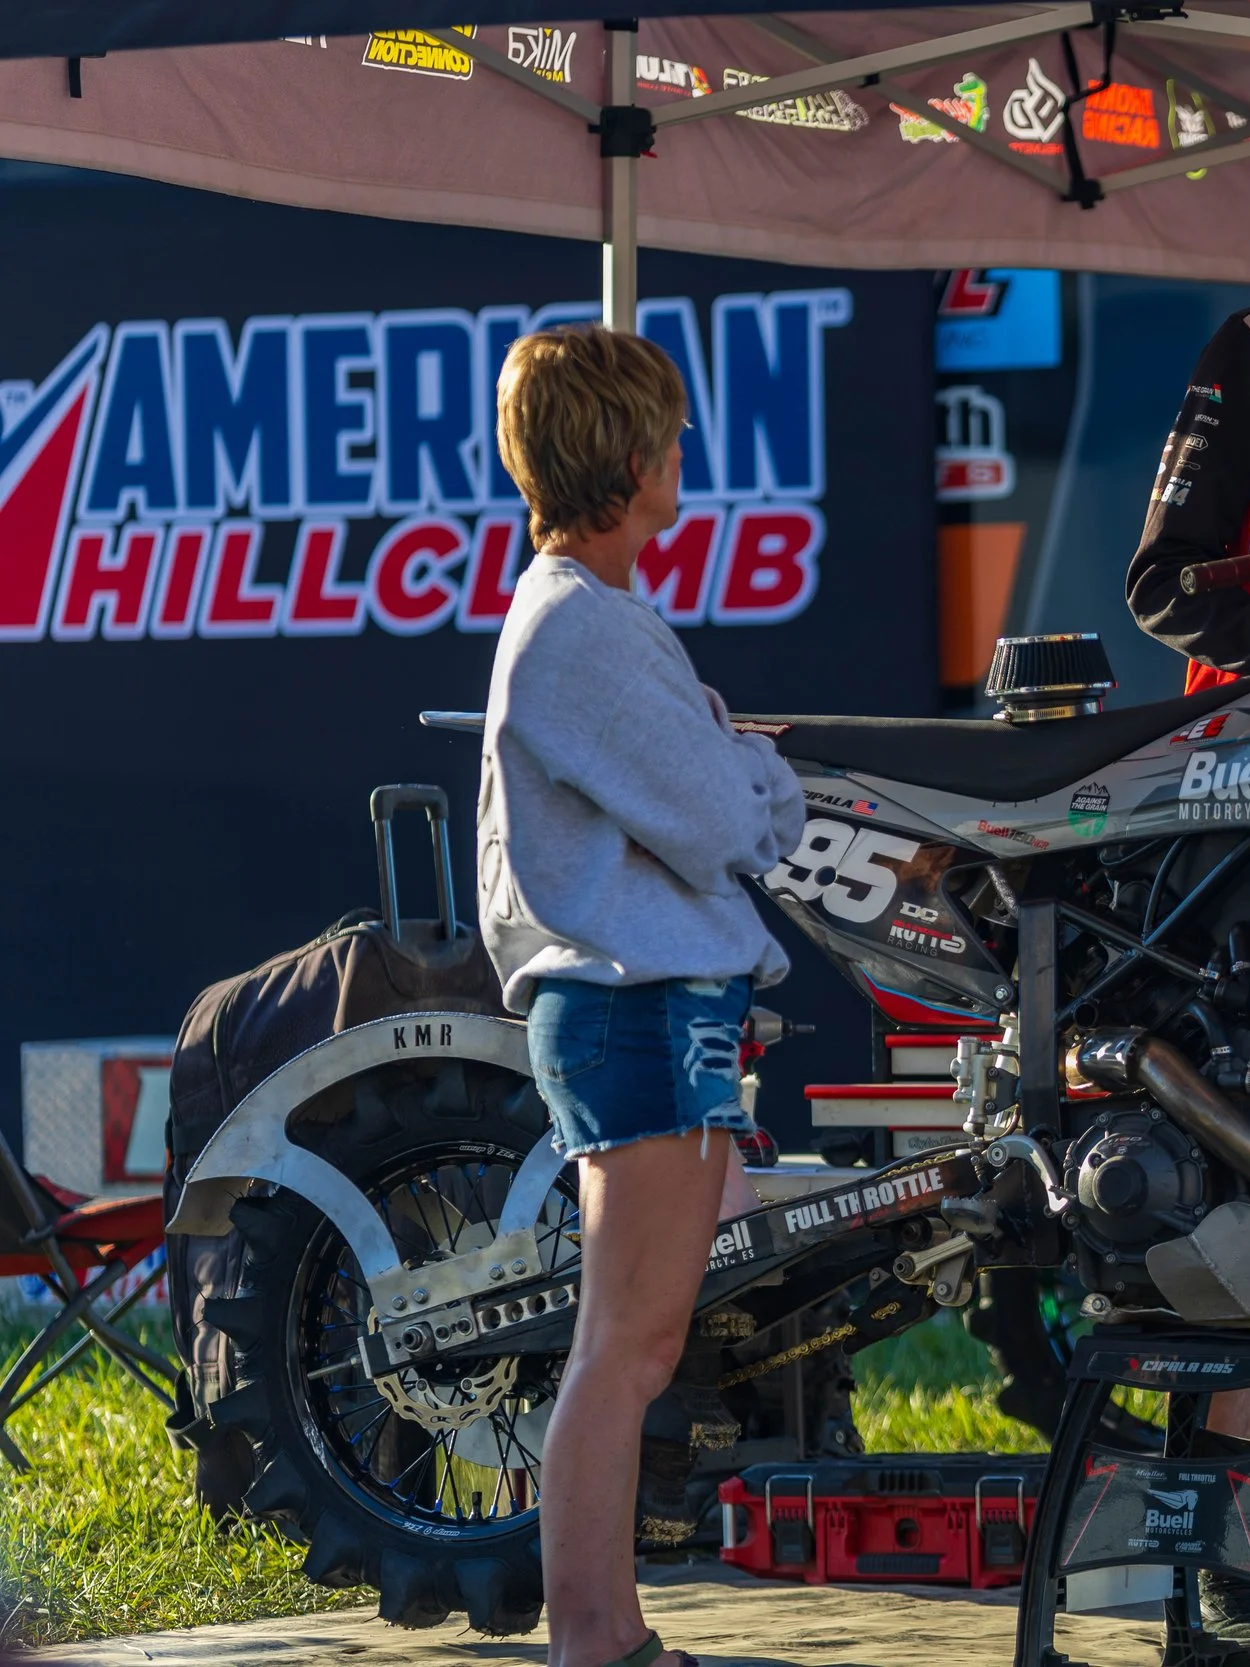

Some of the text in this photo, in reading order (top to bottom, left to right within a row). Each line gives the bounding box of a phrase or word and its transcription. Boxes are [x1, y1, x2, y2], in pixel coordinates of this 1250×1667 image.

[78, 294, 827, 521] AMERIAN
[52, 504, 827, 642] HILLCLMB
[1071, 802, 1086, 810] THE
[1075, 796, 1107, 805] AGAINST
[977, 819, 1010, 838] Buell
[887, 935, 937, 957] RACING
[784, 1200, 835, 1234] FULL
[834, 1168, 944, 1217] THROTTLE
[709, 1220, 752, 1258] ell
[1141, 1360, 1200, 1373] CIPALA
[1146, 1509, 1195, 1530] Buell
[1145, 1527, 1193, 1536] MOTORCYCLES
